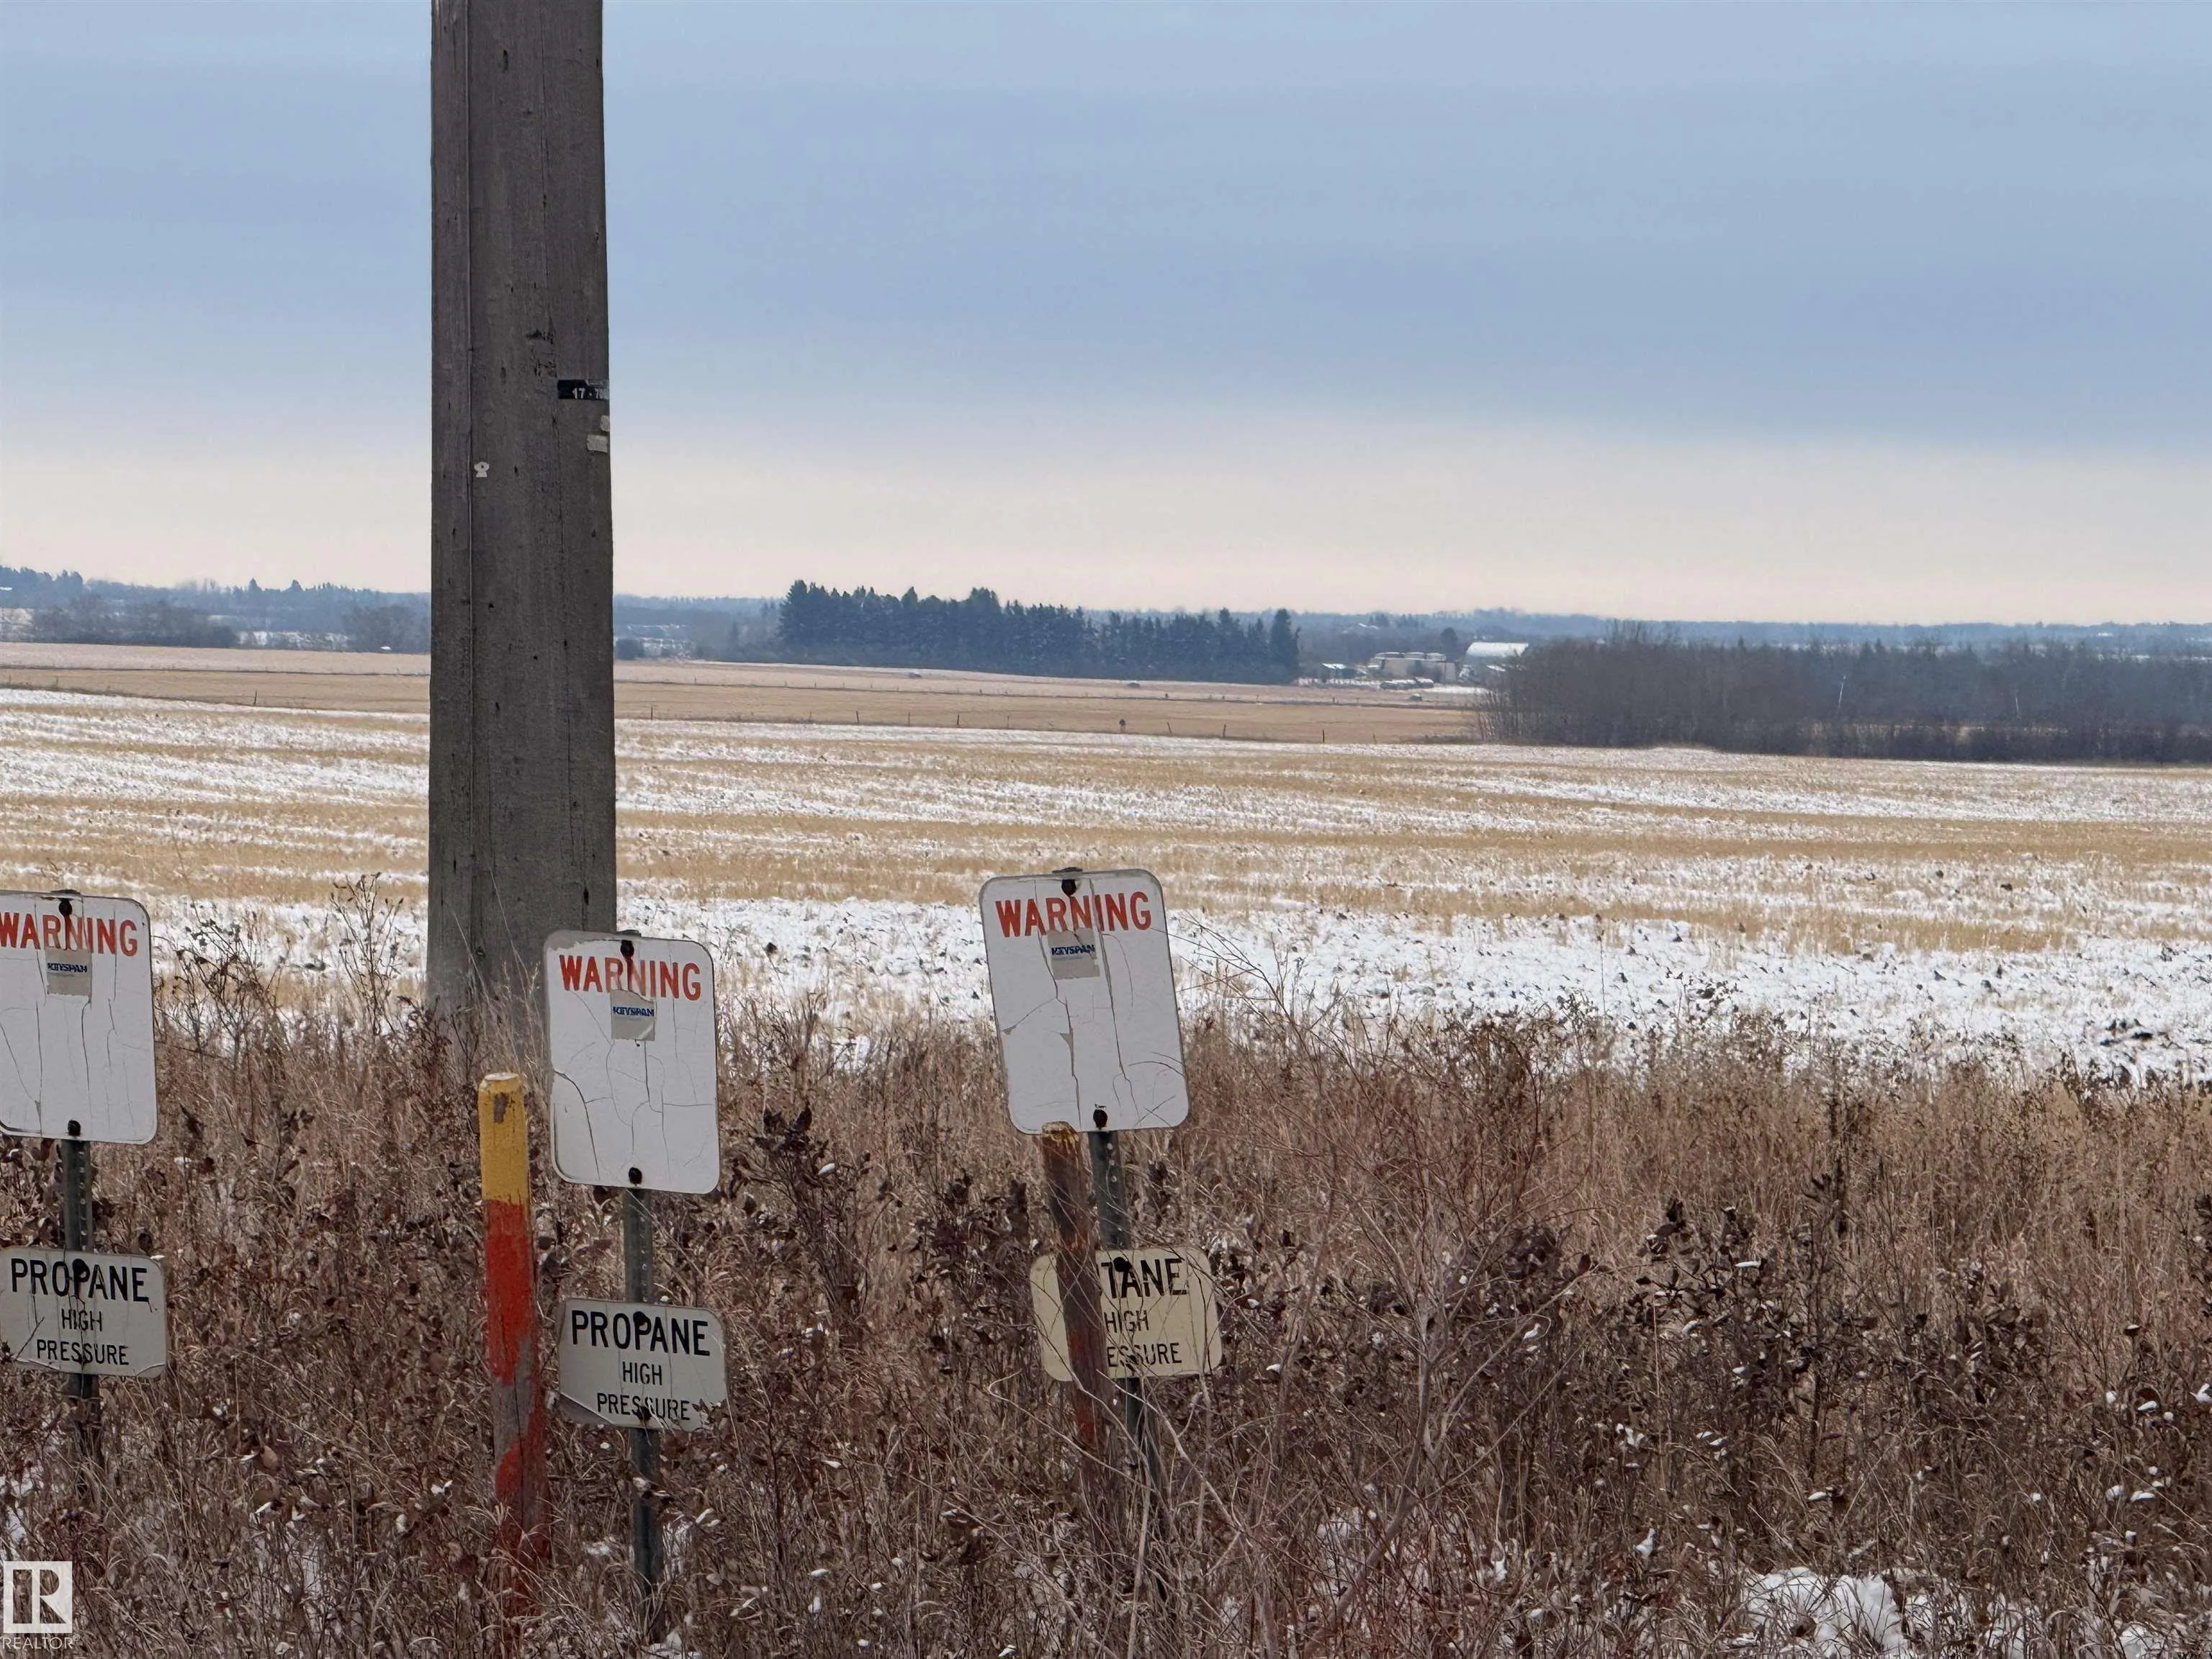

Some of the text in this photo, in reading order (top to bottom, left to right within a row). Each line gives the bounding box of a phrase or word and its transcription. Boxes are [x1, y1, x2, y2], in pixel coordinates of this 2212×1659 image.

[0, 912, 138, 956] WARNING
[995, 891, 1151, 938] WARNING
[559, 955, 701, 1000] WARNING
[11, 1258, 149, 1303] PROPANE
[1101, 1257, 1189, 1299] TANE
[61, 1308, 102, 1332] HIGH
[572, 1310, 710, 1357] PROPANE
[1104, 1310, 1149, 1334] HIGH
[37, 1339, 129, 1366] PRESSURE
[622, 1361, 662, 1385] HIGH
[597, 1393, 691, 1421] PRESSURE
